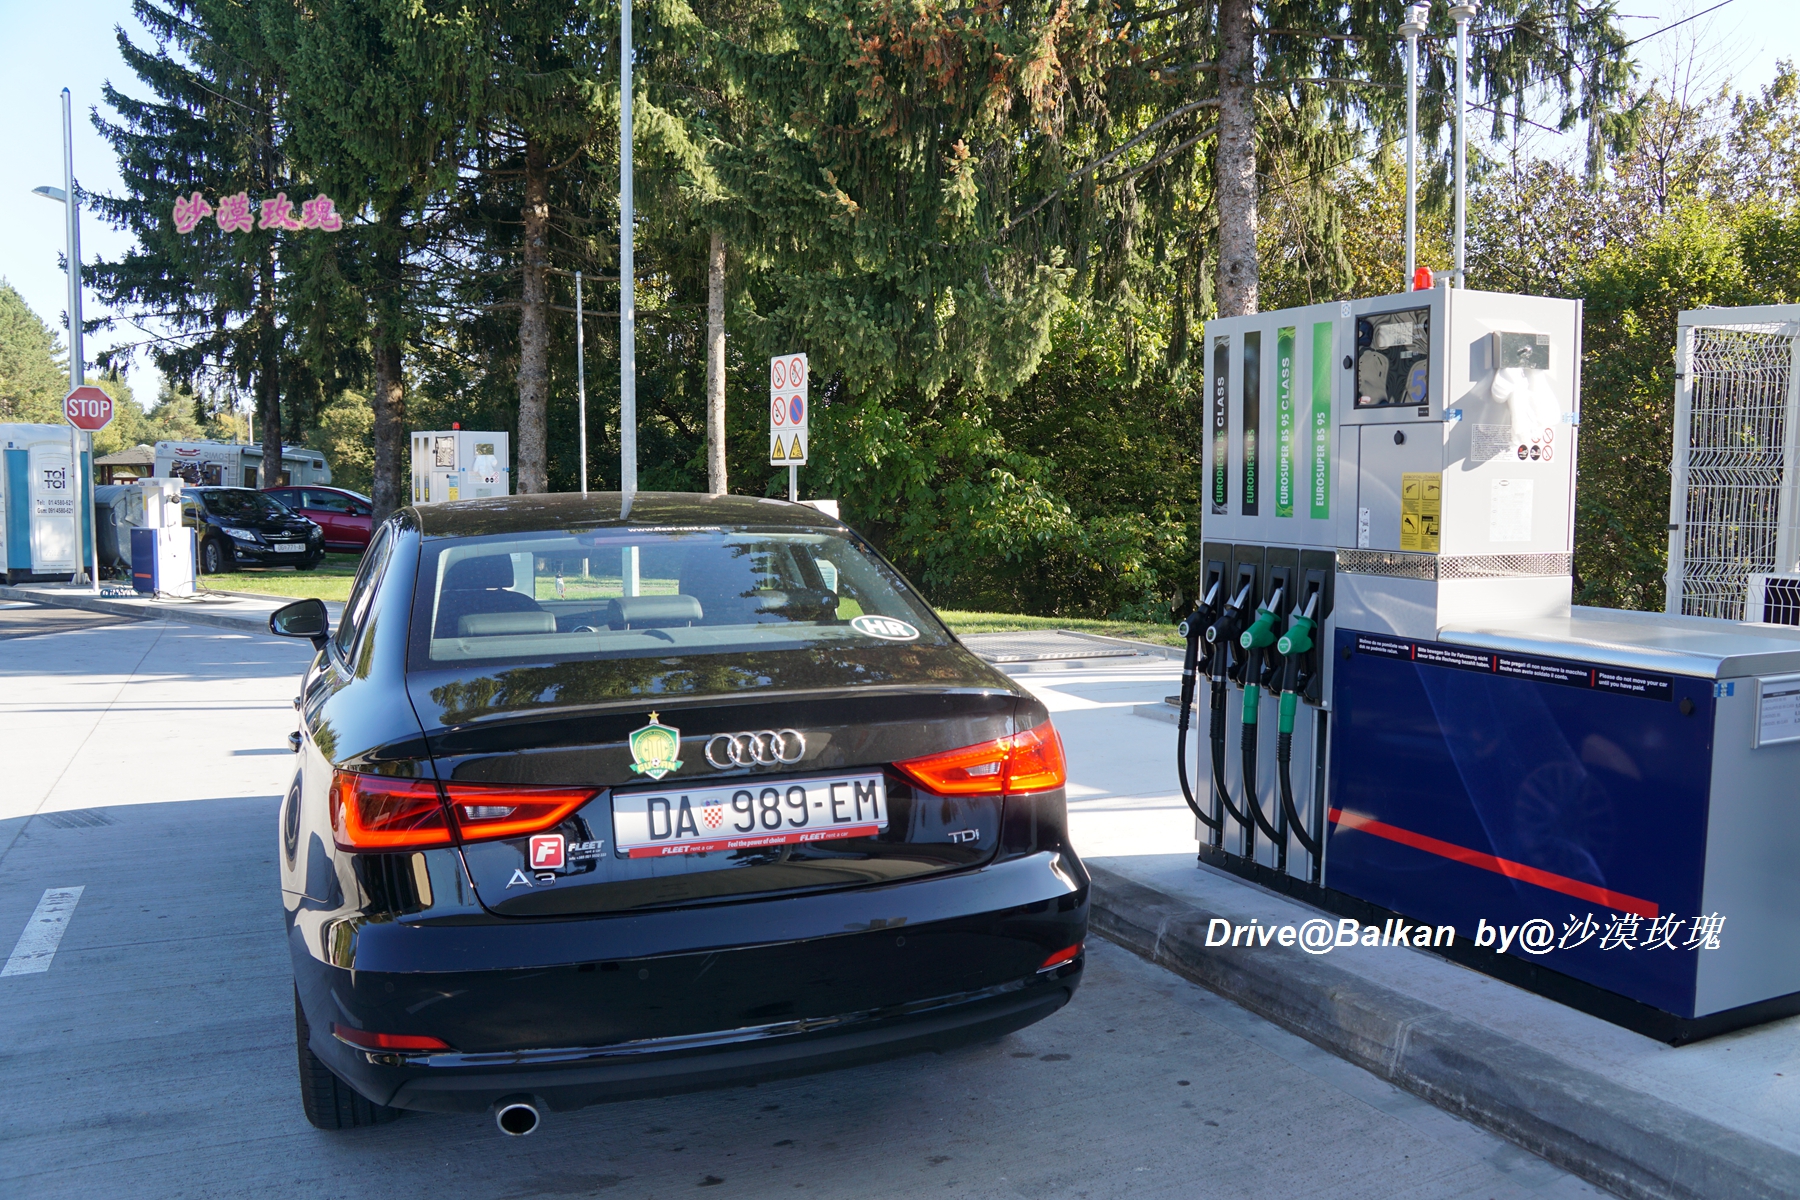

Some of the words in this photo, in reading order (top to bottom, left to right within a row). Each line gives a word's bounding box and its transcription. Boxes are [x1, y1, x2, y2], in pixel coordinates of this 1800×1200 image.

[1281, 357, 1290, 410] CLASS
[1216, 376, 1225, 427] CLASS
[69, 399, 110, 418] STOP
[1281, 414, 1289, 425] 95
[1317, 412, 1325, 425] 95
[1217, 430, 1224, 442] BS
[1248, 429, 1255, 442] BS
[1281, 430, 1289, 442] BS
[1317, 428, 1325, 441] BS
[1216, 446, 1224, 503] EURODIESEL
[1280, 445, 1288, 505] EUROSUPER
[1316, 444, 1324, 506] EUROSUPER
[44, 480, 65, 489] TOI
[862, 619, 910, 637] HR
[1442, 656, 1461, 665] Rechnung
[646, 795, 699, 840] DA
[732, 780, 879, 832] 989-EM
[800, 832, 826, 841] FLEET
[948, 829, 980, 843] TDI
[568, 840, 604, 852] FLEET
[662, 845, 690, 854] FLEET
[506, 868, 556, 889] A3
